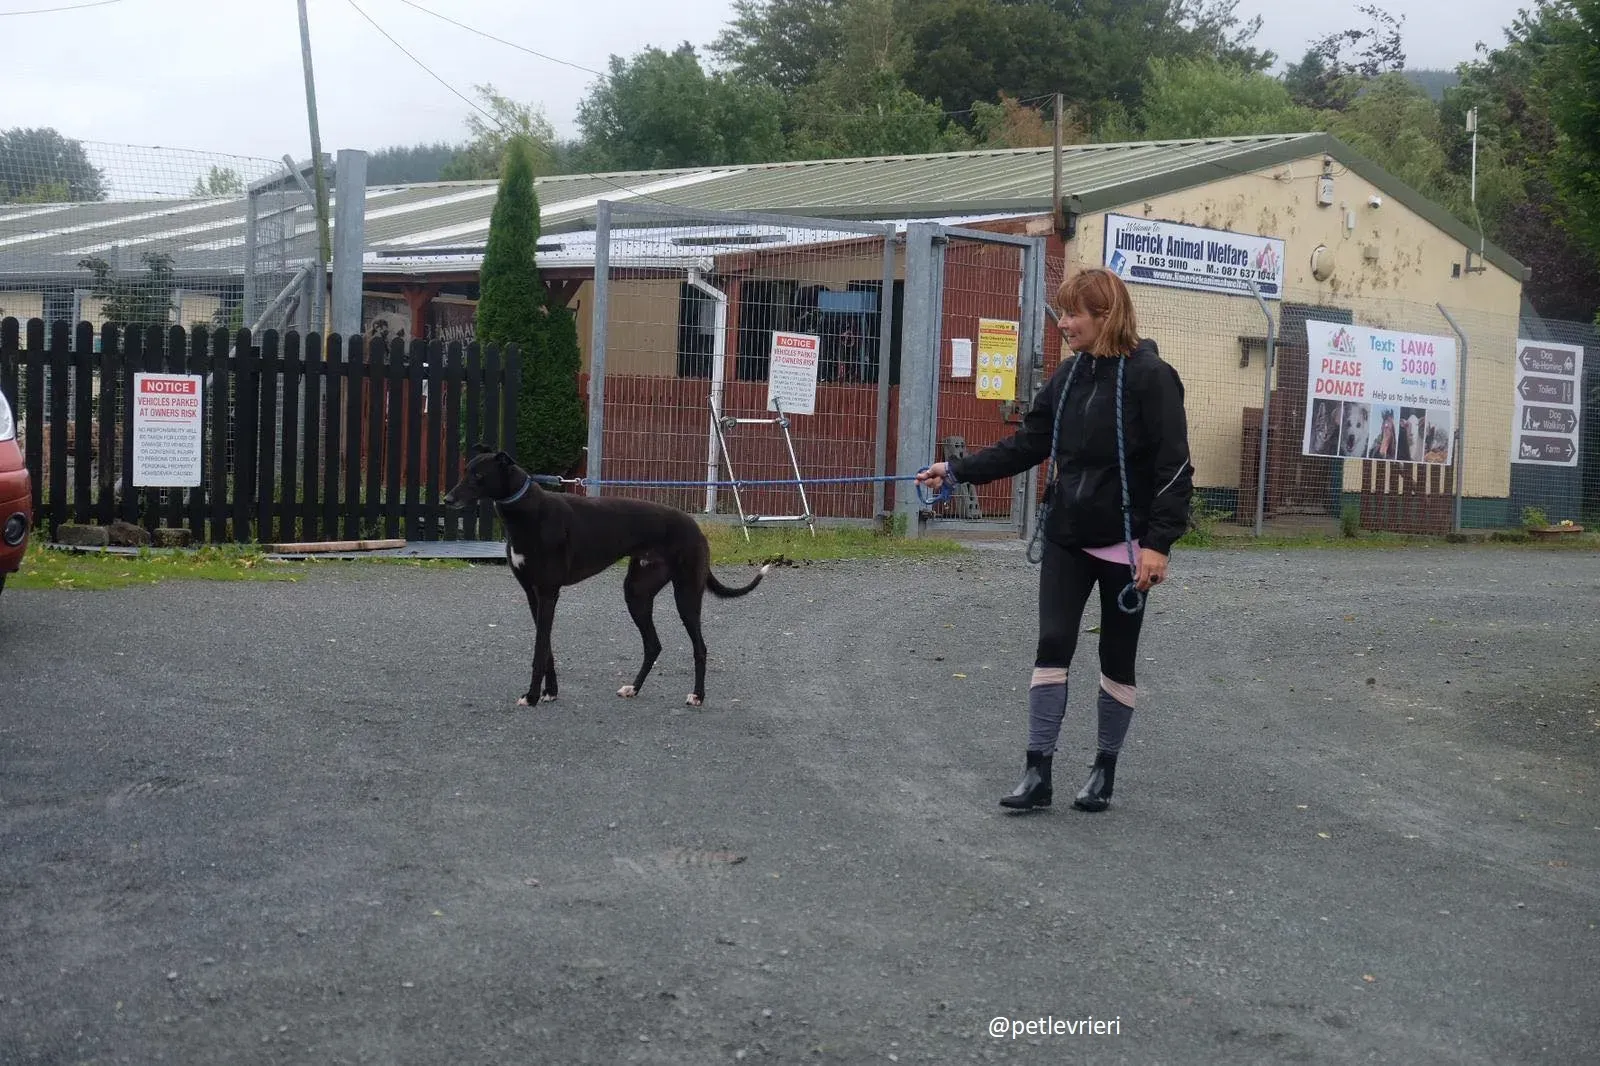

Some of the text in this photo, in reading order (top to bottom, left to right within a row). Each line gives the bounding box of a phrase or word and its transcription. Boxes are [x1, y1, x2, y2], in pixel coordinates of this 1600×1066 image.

[1126, 222, 1151, 232] Welcome
[1115, 228, 1164, 255] Limerick
[1166, 235, 1204, 261] Animal
[1207, 240, 1249, 267] Welfare
[1148, 256, 1166, 268] 063
[1168, 259, 1189, 271] 91110
[1221, 266, 1238, 276] 087
[1240, 268, 1256, 279] 637
[1257, 270, 1276, 281] 1044
[780, 337, 812, 348] NOTICE
[1370, 335, 1396, 353] Text:
[1400, 338, 1435, 357] LAW4
[774, 348, 816, 359] VEHICLES PARKED
[1540, 350, 1553, 362] Dog
[781, 356, 803, 365] OWNERS
[803, 359, 816, 367] RISK
[1321, 358, 1362, 377] PLEASE
[1382, 357, 1436, 376] to 50300
[1532, 359, 1563, 374] Re-Homing
[147, 381, 190, 393] NOTICE
[1315, 378, 1365, 398] DONATE
[1537, 383, 1558, 395] Toilets
[137, 396, 199, 408] VEHICLES PARKED
[1372, 389, 1387, 402] Help
[1396, 393, 1403, 401] to
[1404, 393, 1418, 405] help
[1418, 395, 1428, 405] the
[1429, 396, 1451, 407] animals
[139, 407, 198, 418] AT OWNERS RISK
[1548, 409, 1562, 420] Dog
[1542, 419, 1566, 434] Walking
[1545, 444, 1561, 454] Farm
